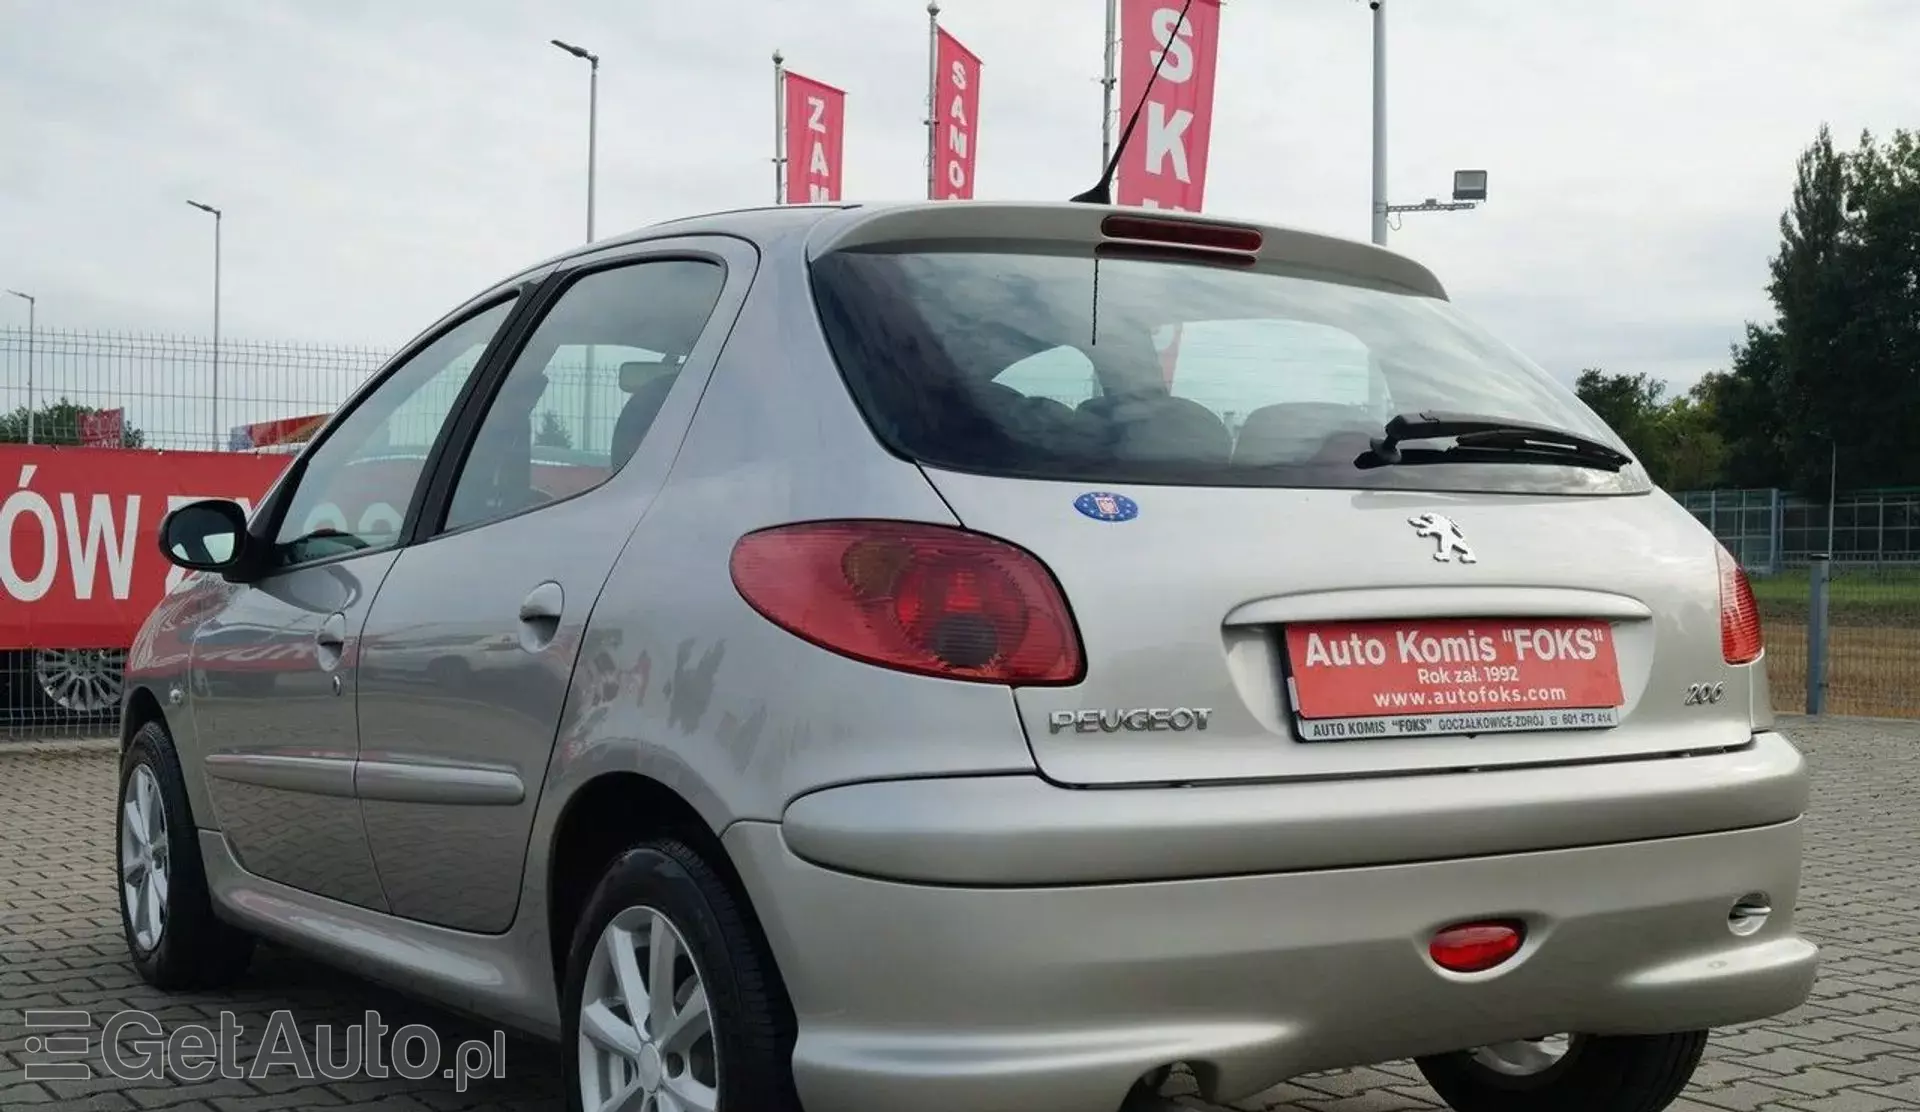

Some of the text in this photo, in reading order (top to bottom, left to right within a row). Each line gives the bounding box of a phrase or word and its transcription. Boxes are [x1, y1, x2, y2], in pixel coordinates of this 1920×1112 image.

[1143, 7, 1194, 211] SK
[948, 60, 967, 200] SAMO
[1305, 628, 1604, 667] Auto Komis "FOKS"
[1417, 665, 1520, 685] Rok zał. 1992
[1373, 685, 1566, 707] www.autofoks.com
[1684, 681, 1724, 706] 206
[1049, 706, 1212, 735] PEUGEOT
[1313, 722, 1345, 737] AUTO
[1349, 720, 1386, 735] KOMIS
[1438, 715, 1544, 731] GOCZAŁKOWICE-ZDRÓJ
[1562, 713, 1578, 724] 601
[1580, 713, 1596, 723] 473
